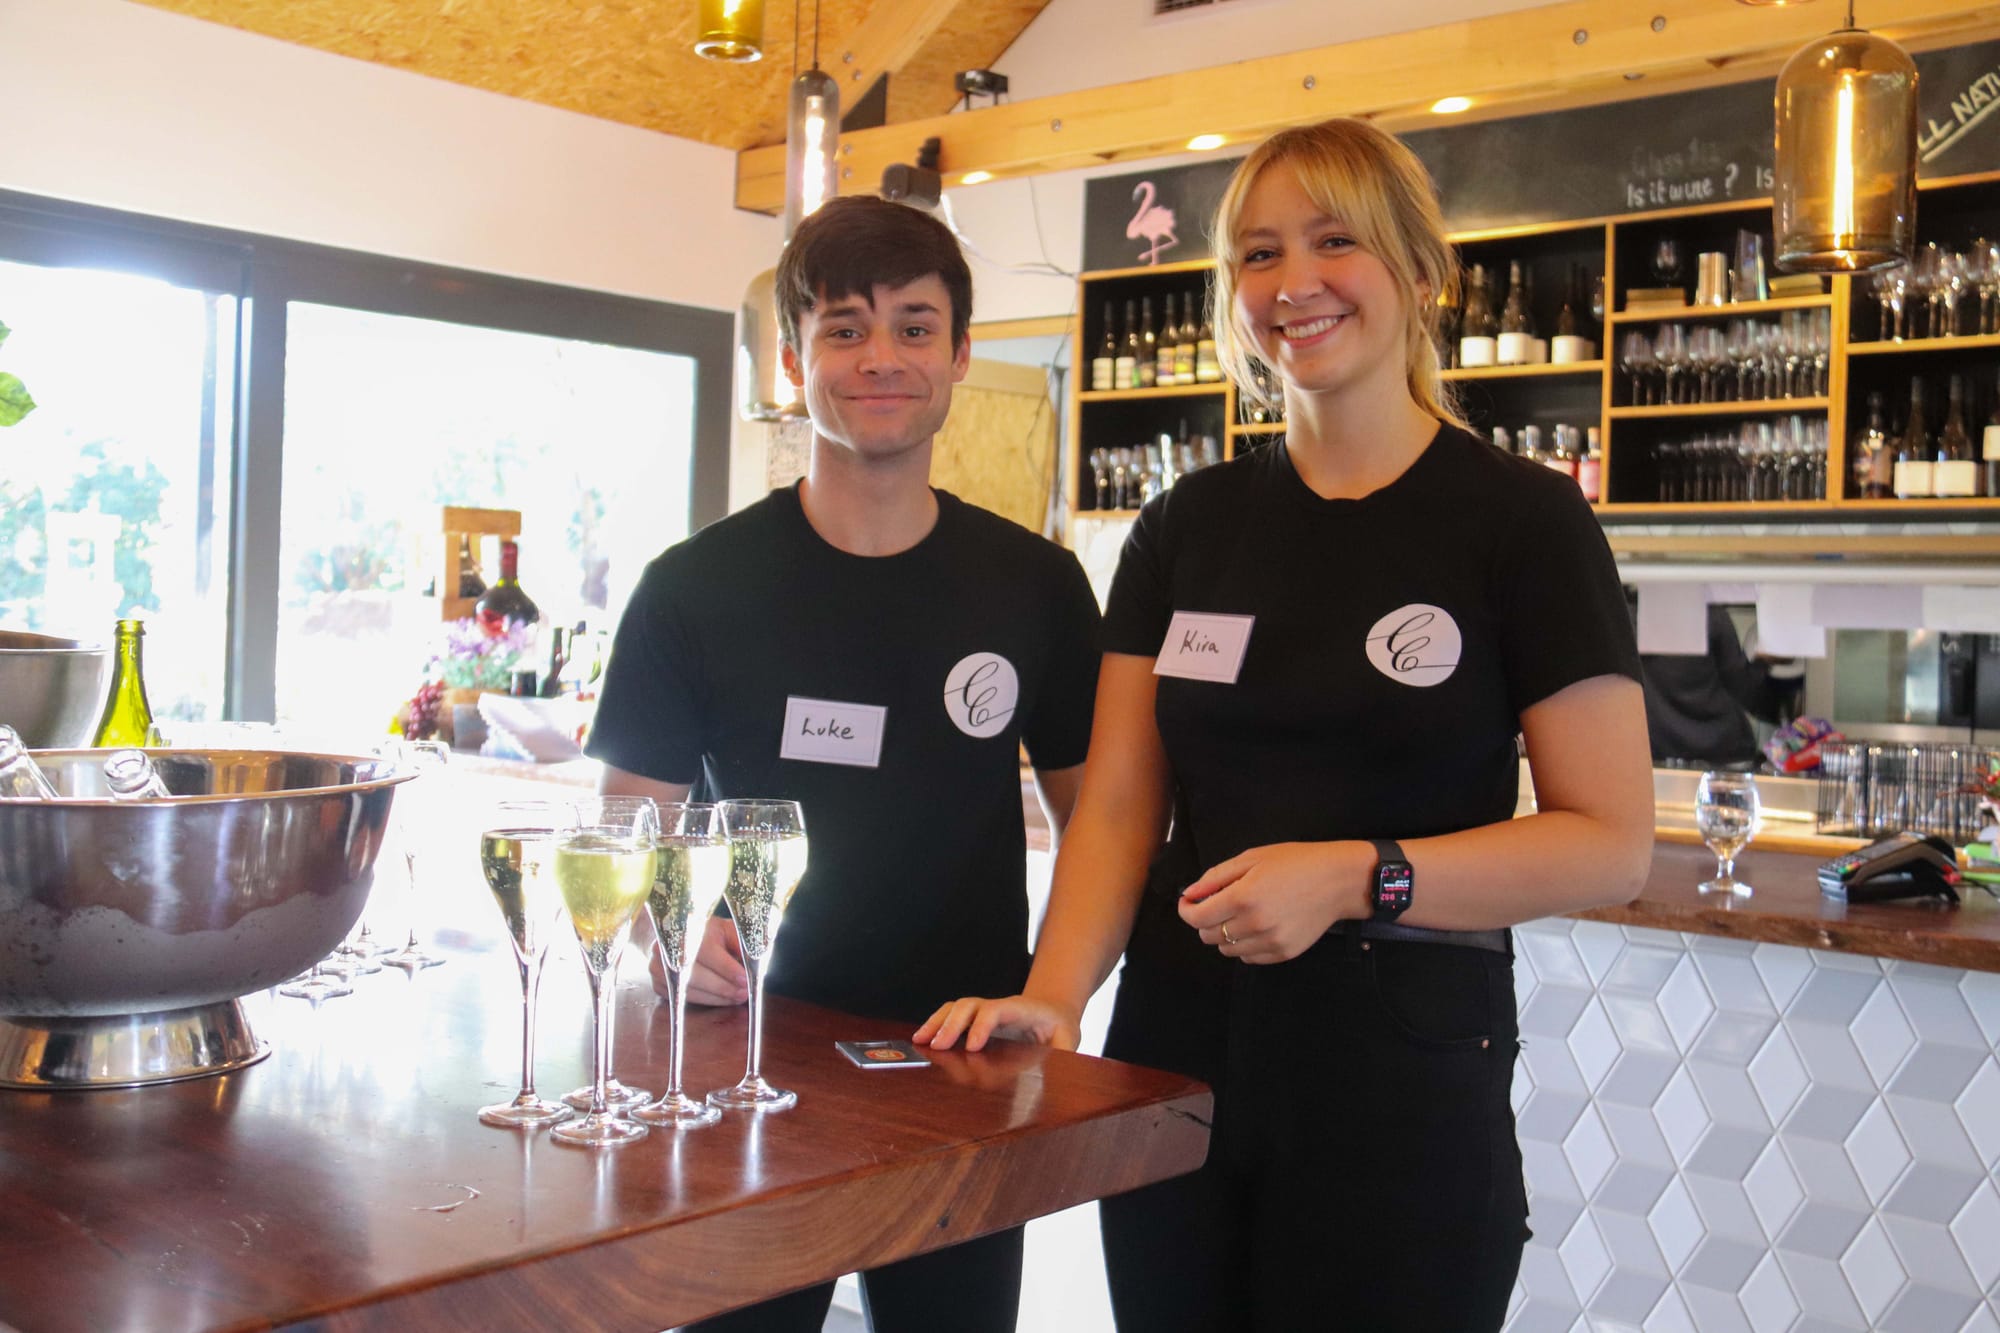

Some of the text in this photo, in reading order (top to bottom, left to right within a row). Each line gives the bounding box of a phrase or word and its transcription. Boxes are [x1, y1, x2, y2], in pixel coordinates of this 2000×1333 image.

[1627, 182, 1646, 208] Is
[1178, 629, 1220, 656] Kira
[800, 717, 855, 741] Luke
